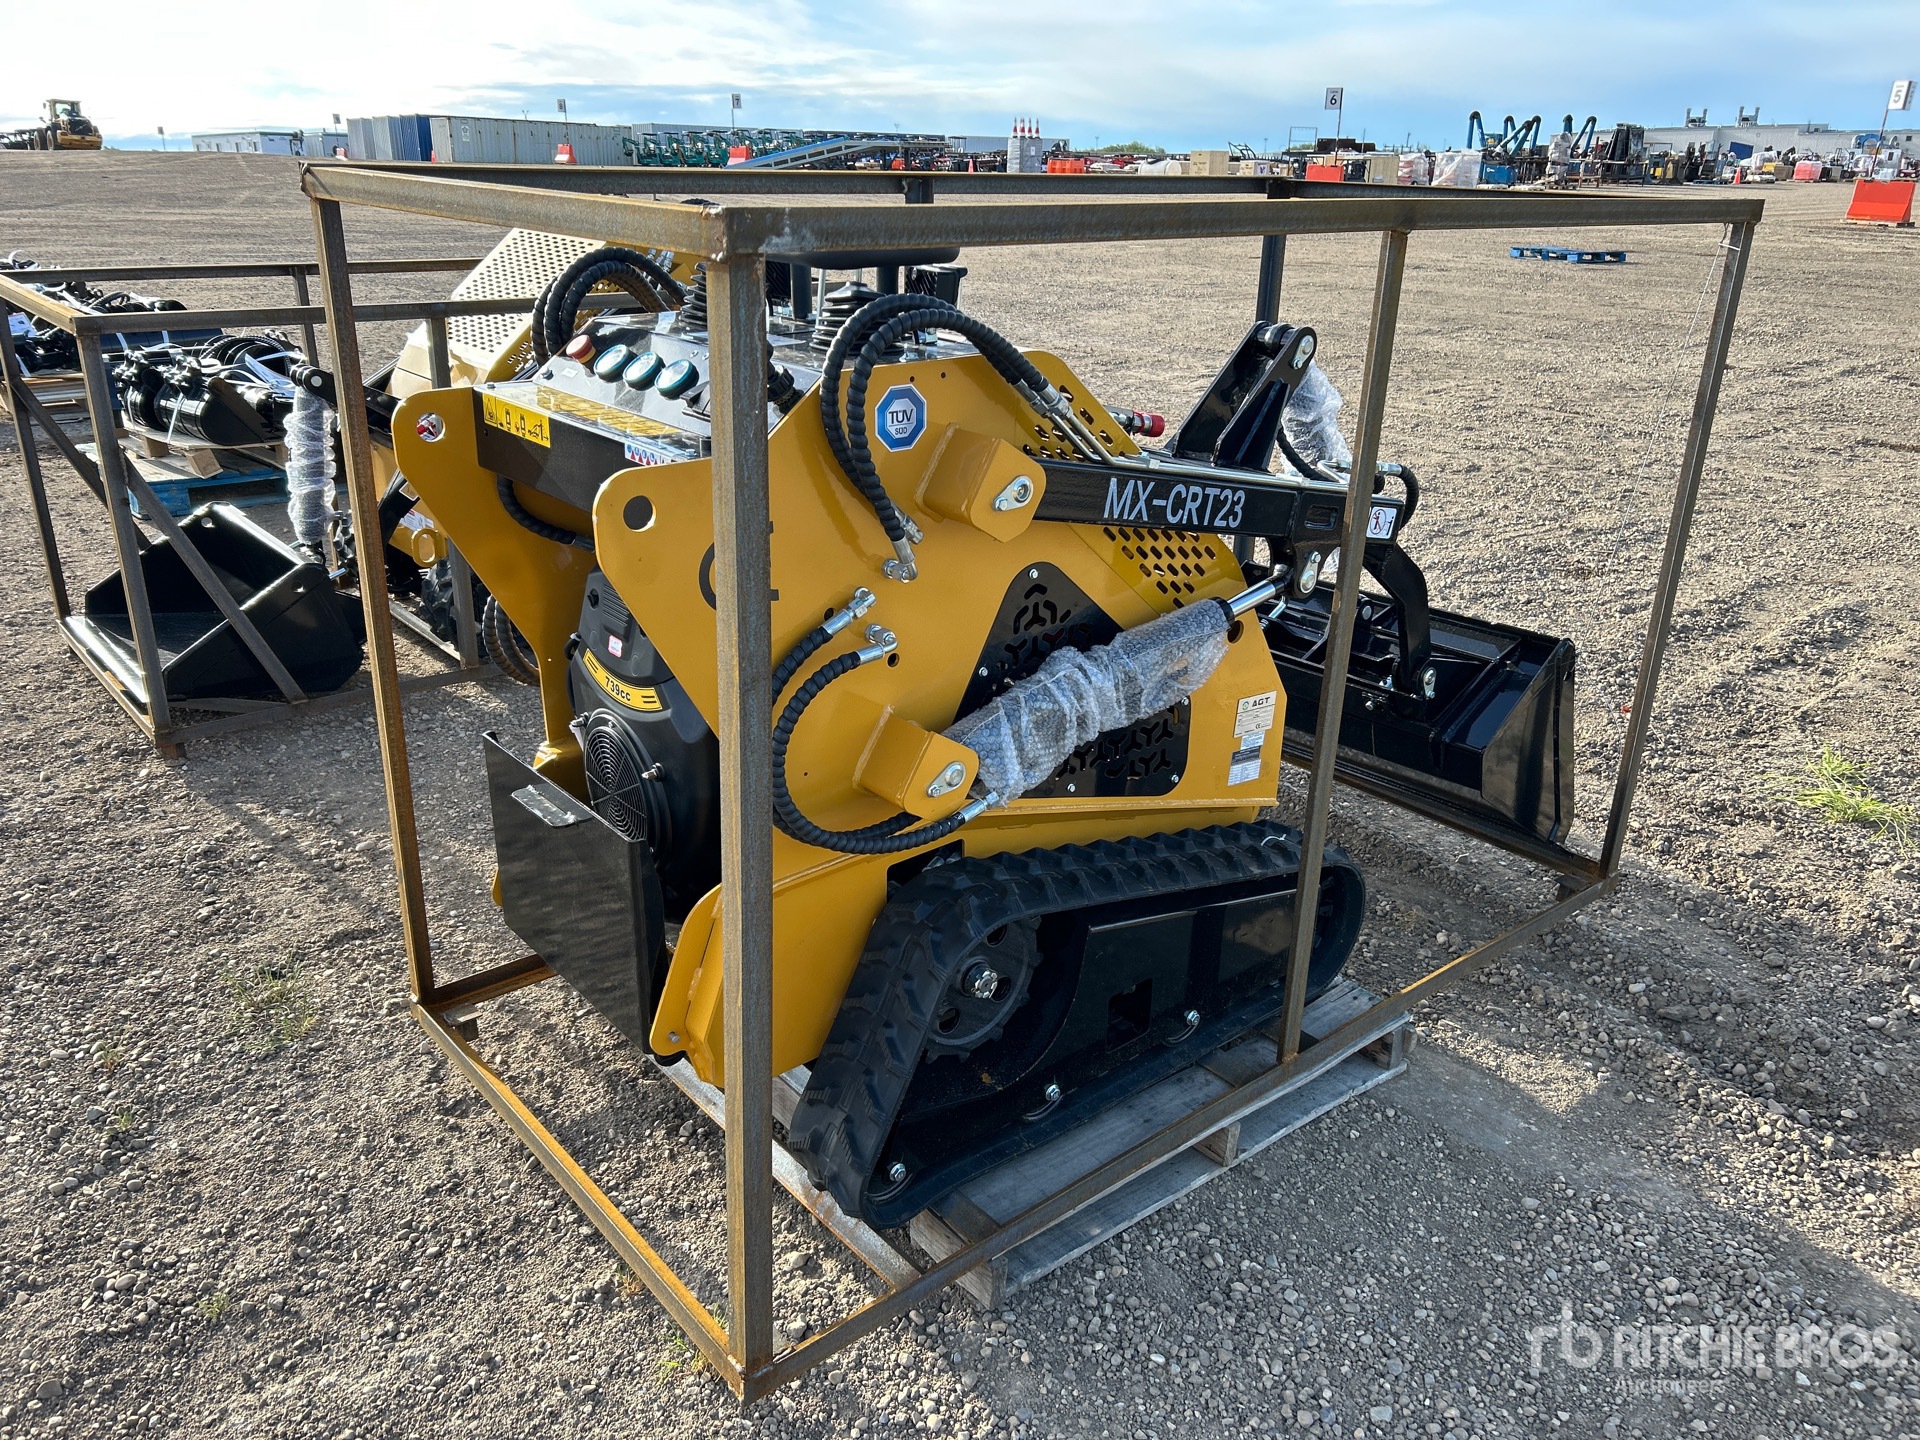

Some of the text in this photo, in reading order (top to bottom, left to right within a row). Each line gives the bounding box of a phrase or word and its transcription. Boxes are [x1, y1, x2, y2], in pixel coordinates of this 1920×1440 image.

[735, 98, 740, 106] 7
[1330, 95, 1337, 105] 6
[1893, 89, 1902, 103] 5
[888, 408, 914, 424] TÜV
[1103, 477, 1245, 529] MX-CRT23
[605, 675, 631, 702] 739cc
[1251, 696, 1271, 708] AGT
